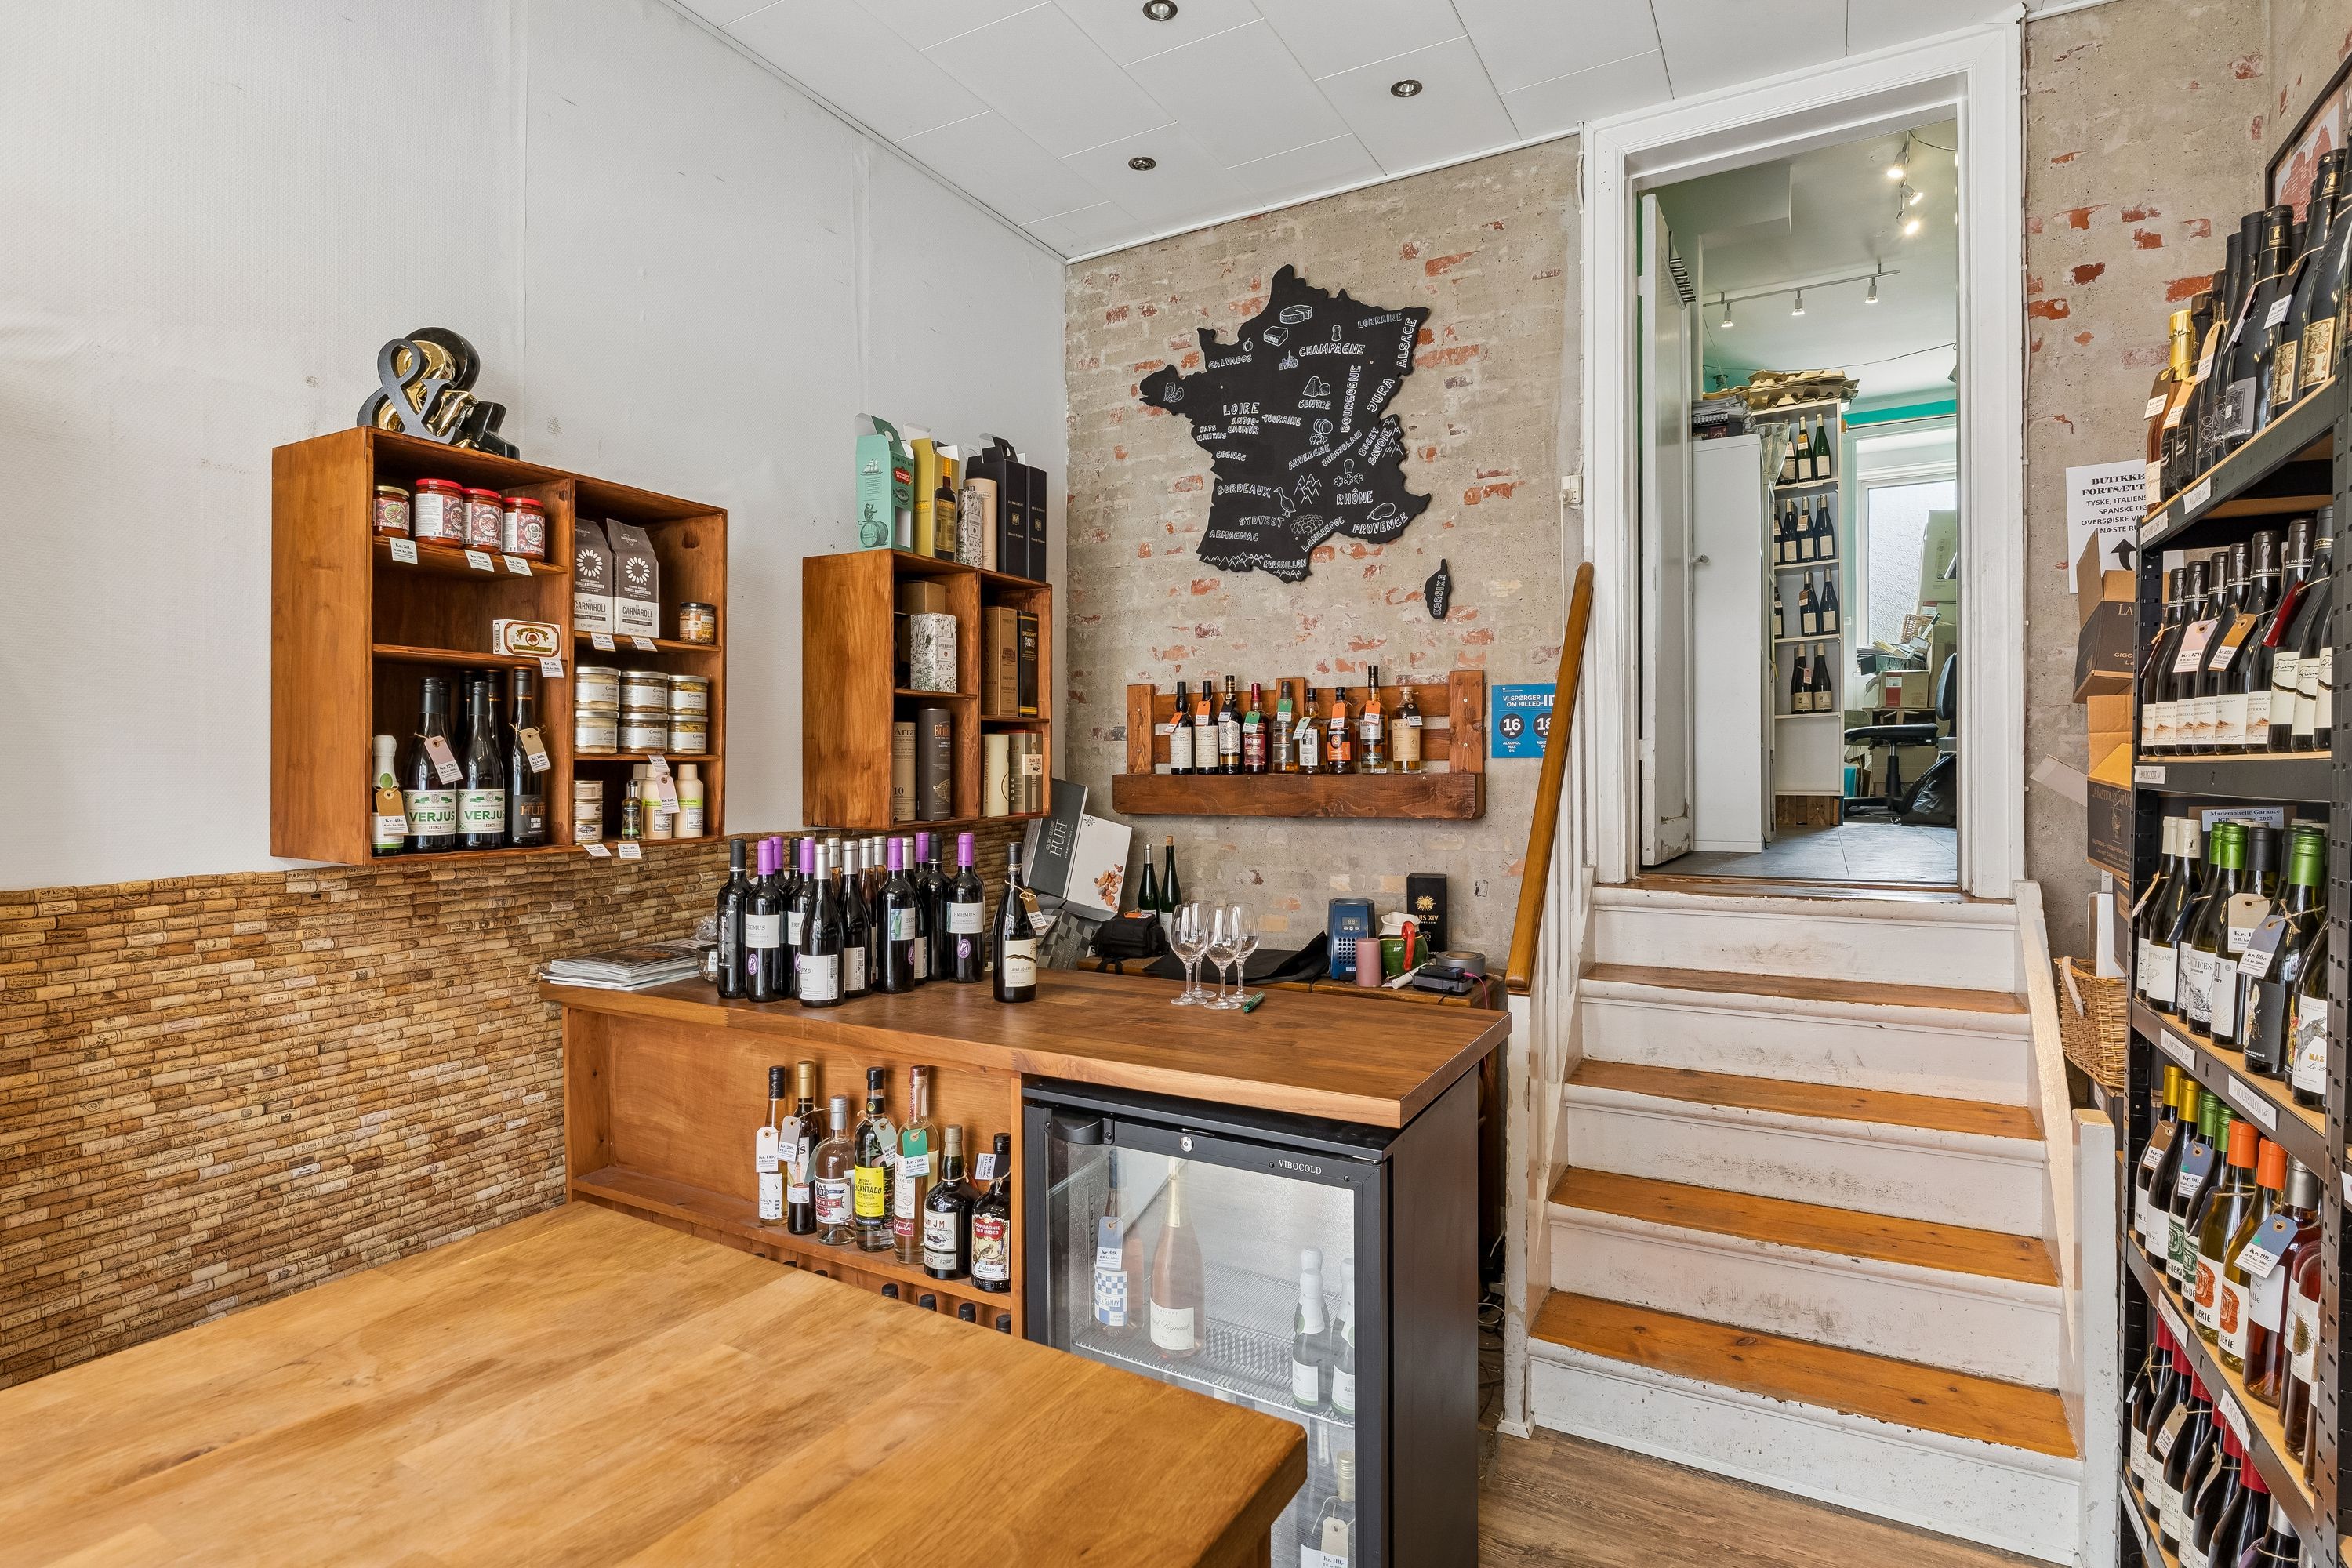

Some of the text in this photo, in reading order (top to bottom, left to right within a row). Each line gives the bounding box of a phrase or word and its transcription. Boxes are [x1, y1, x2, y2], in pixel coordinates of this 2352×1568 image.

[1357, 313, 1403, 328] LORRAINE
[1396, 318, 1417, 368] ALSACE
[1298, 343, 1366, 357] CHAMPAGNE
[1208, 354, 1253, 369] CALVADOS
[1340, 365, 1361, 434] BOURGOGNE
[1366, 376, 1396, 412] JURA
[1223, 401, 1261, 416] LOIRE
[1298, 398, 1331, 410] CENTRE
[1231, 416, 1260, 426] ANJOU-
[1261, 414, 1301, 426] TOURAINE
[1196, 431, 1227, 441] NANTAIS
[1227, 425, 1259, 435] SAUMUR
[1357, 426, 1380, 457] BUGEY
[1367, 427, 1392, 466] SAVOIE
[1321, 430, 1363, 467] BEAUJOLAIS
[1215, 450, 1247, 462] COGNAC
[1288, 443, 1331, 470] AUVERGNE
[2092, 473, 2146, 485] BUTIKKE
[1217, 483, 1272, 499] BORDEAUX
[2082, 483, 2146, 496] FORTSÆTT
[1336, 489, 1373, 505] RHÔNE
[2086, 499, 2112, 507] TYSKE,
[2098, 506, 2134, 515] SPANSKE
[1239, 516, 1285, 528] SYDVEST
[1352, 512, 1409, 535] PROVENCE
[2081, 516, 2129, 526] OVERSØISKE
[1301, 516, 1345, 553] LANGUEDOC
[2100, 525, 2127, 534] NÆSTE
[1209, 530, 1259, 542] ARMAGNAC
[1263, 558, 1307, 569] ROUSSILLON
[1433, 574, 1446, 615] KORSIKA
[574, 601, 606, 612] CARNAROLI
[622, 606, 652, 618] CARNAROLI
[1503, 718, 1521, 731] 16
[893, 786, 904, 795] 10
[408, 811, 456, 822] VERJUS
[464, 809, 505, 821] VERJUS
[1050, 818, 1068, 857] HUFF
[2309, 1053, 2325, 1062] MAS
[1277, 1159, 1322, 1175] VIBOCOLD
[934, 1220, 945, 1229] J.M
[975, 1222, 1001, 1231] COMPAGNIE
[2249, 1248, 2272, 1263] Kr. 99,-
